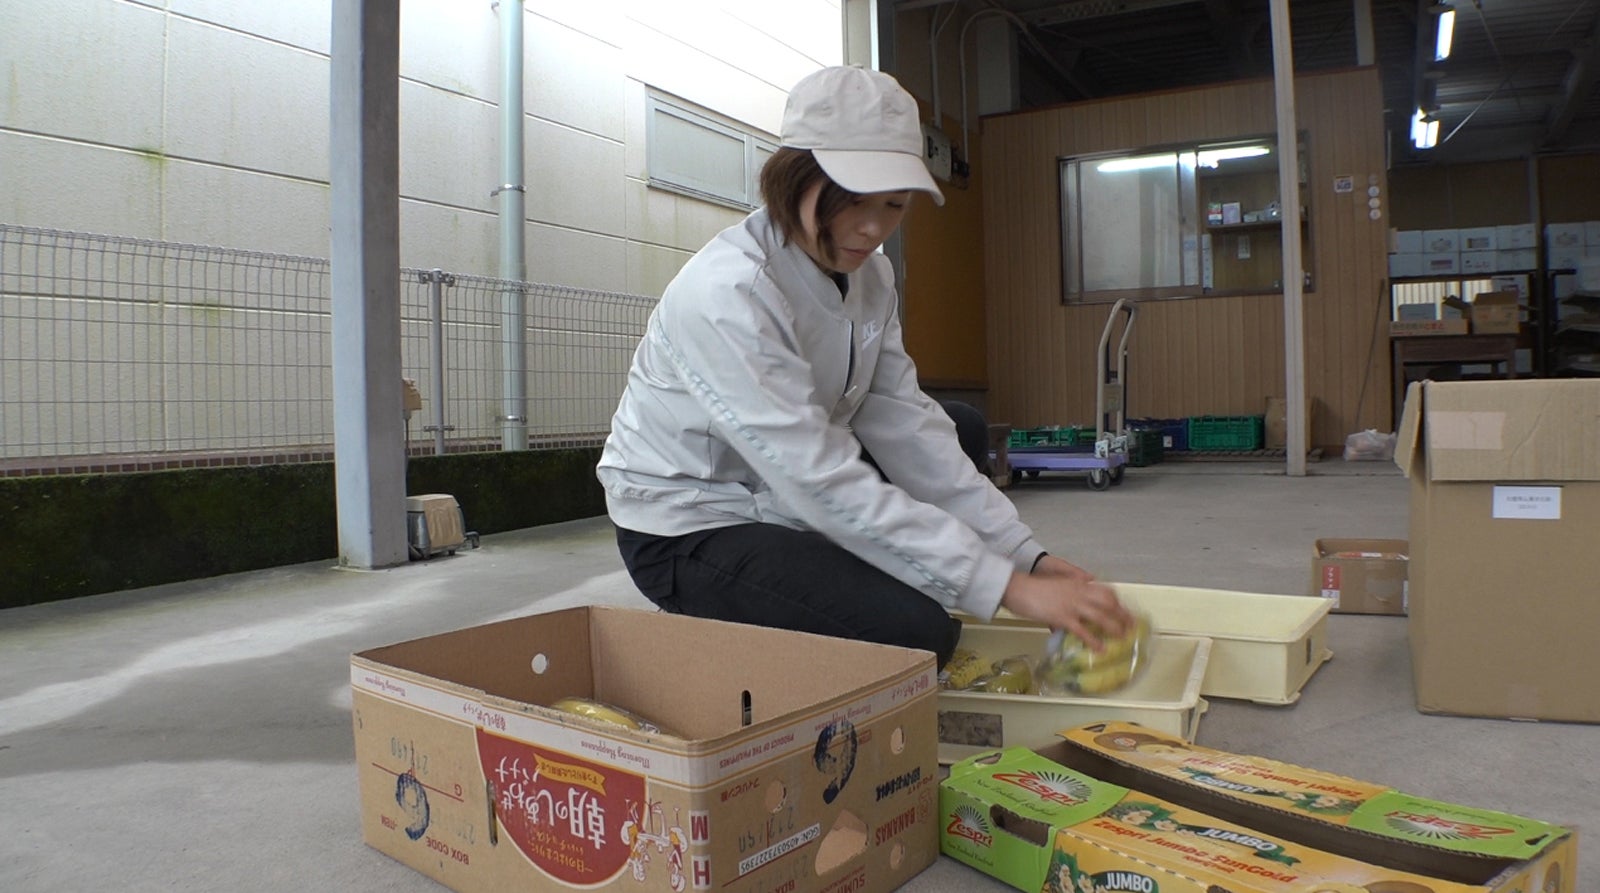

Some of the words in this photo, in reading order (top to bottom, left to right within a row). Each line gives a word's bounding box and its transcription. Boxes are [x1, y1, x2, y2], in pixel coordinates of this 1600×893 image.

[752, 746, 762, 757] THE
[764, 742, 770, 753] OF
[770, 733, 794, 750] PRODUCT
[720, 749, 752, 768] PHILIPPINES
[494, 756, 539, 786] バナナ
[454, 784, 463, 796] G
[992, 770, 1088, 806] Zespri
[1193, 772, 1257, 794] JUMBO
[1308, 781, 1364, 798] Zespri
[690, 814, 708, 841] M
[800, 826, 819, 841] GGN:
[874, 806, 916, 846] BANANAS
[946, 812, 994, 848] Zespri
[425, 836, 449, 855] CODE
[1198, 828, 1278, 852] JUMBO
[450, 847, 470, 865] BOX
[740, 836, 800, 874] 4050373227395
[1093, 820, 1150, 842] Zespri
[1147, 837, 1208, 858] Jumbo
[1210, 854, 1299, 884] SunGold
[693, 860, 710, 886] H
[1105, 872, 1153, 891] JUMBO
